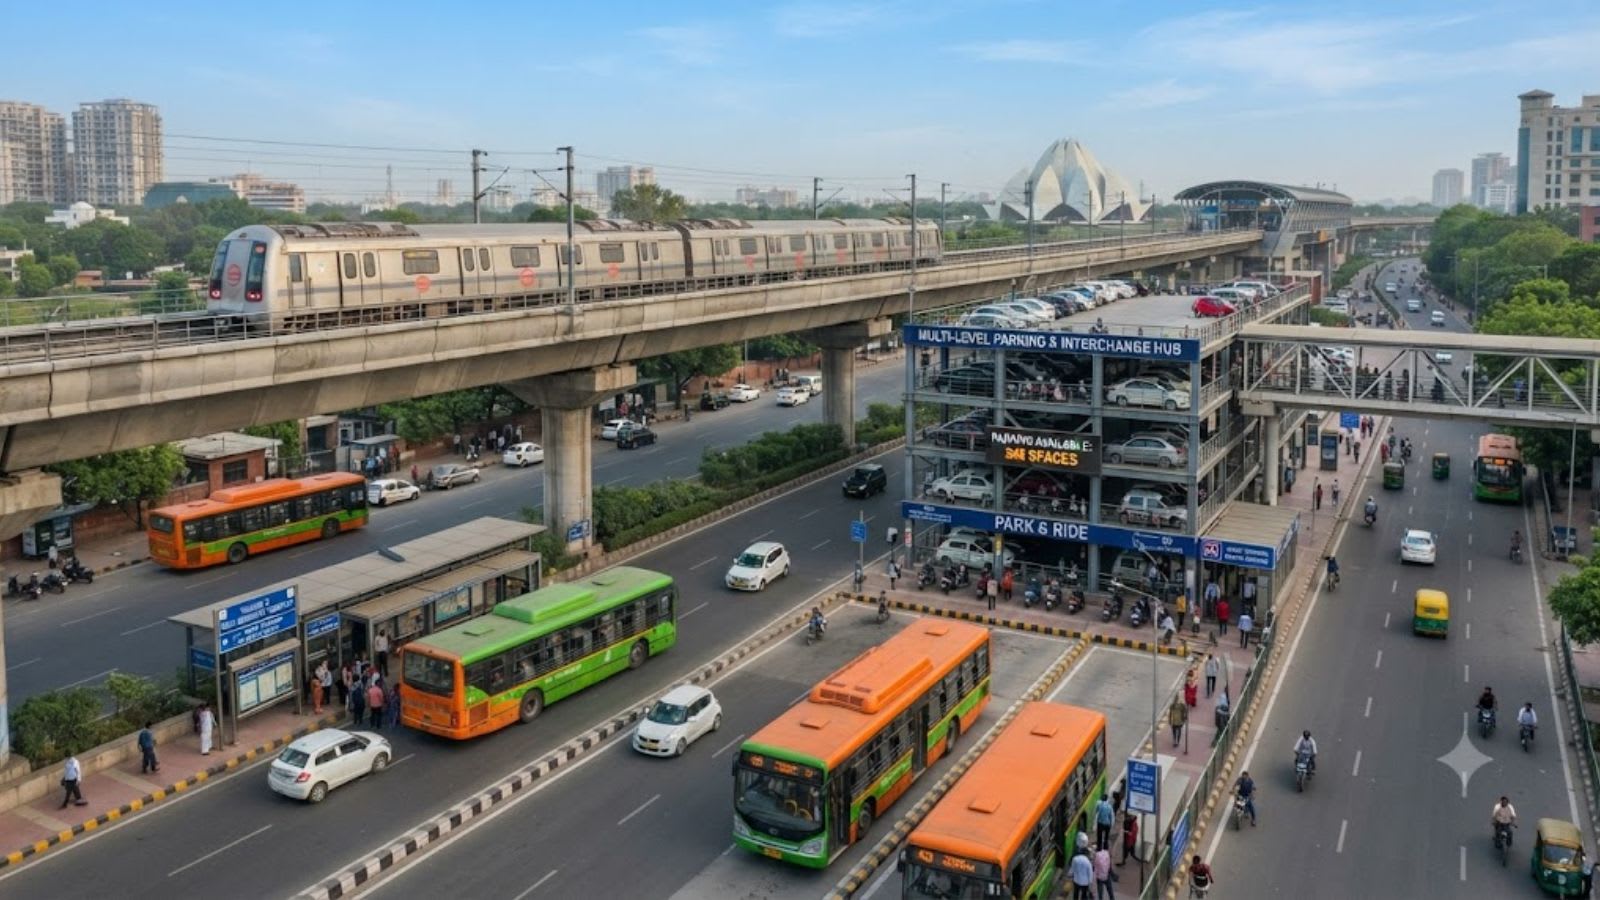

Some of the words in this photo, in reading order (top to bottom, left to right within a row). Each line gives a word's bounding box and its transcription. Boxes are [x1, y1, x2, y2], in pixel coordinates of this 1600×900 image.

[918, 329, 991, 346] MULTI-LEVEL
[993, 333, 1046, 348] PARKING
[1049, 335, 1057, 348] &
[1061, 336, 1151, 354] INTERCHANGE
[1154, 341, 1182, 356] HUB
[994, 515, 1035, 533] PARK
[1038, 521, 1048, 535] &
[1053, 522, 1089, 541] RIDE
